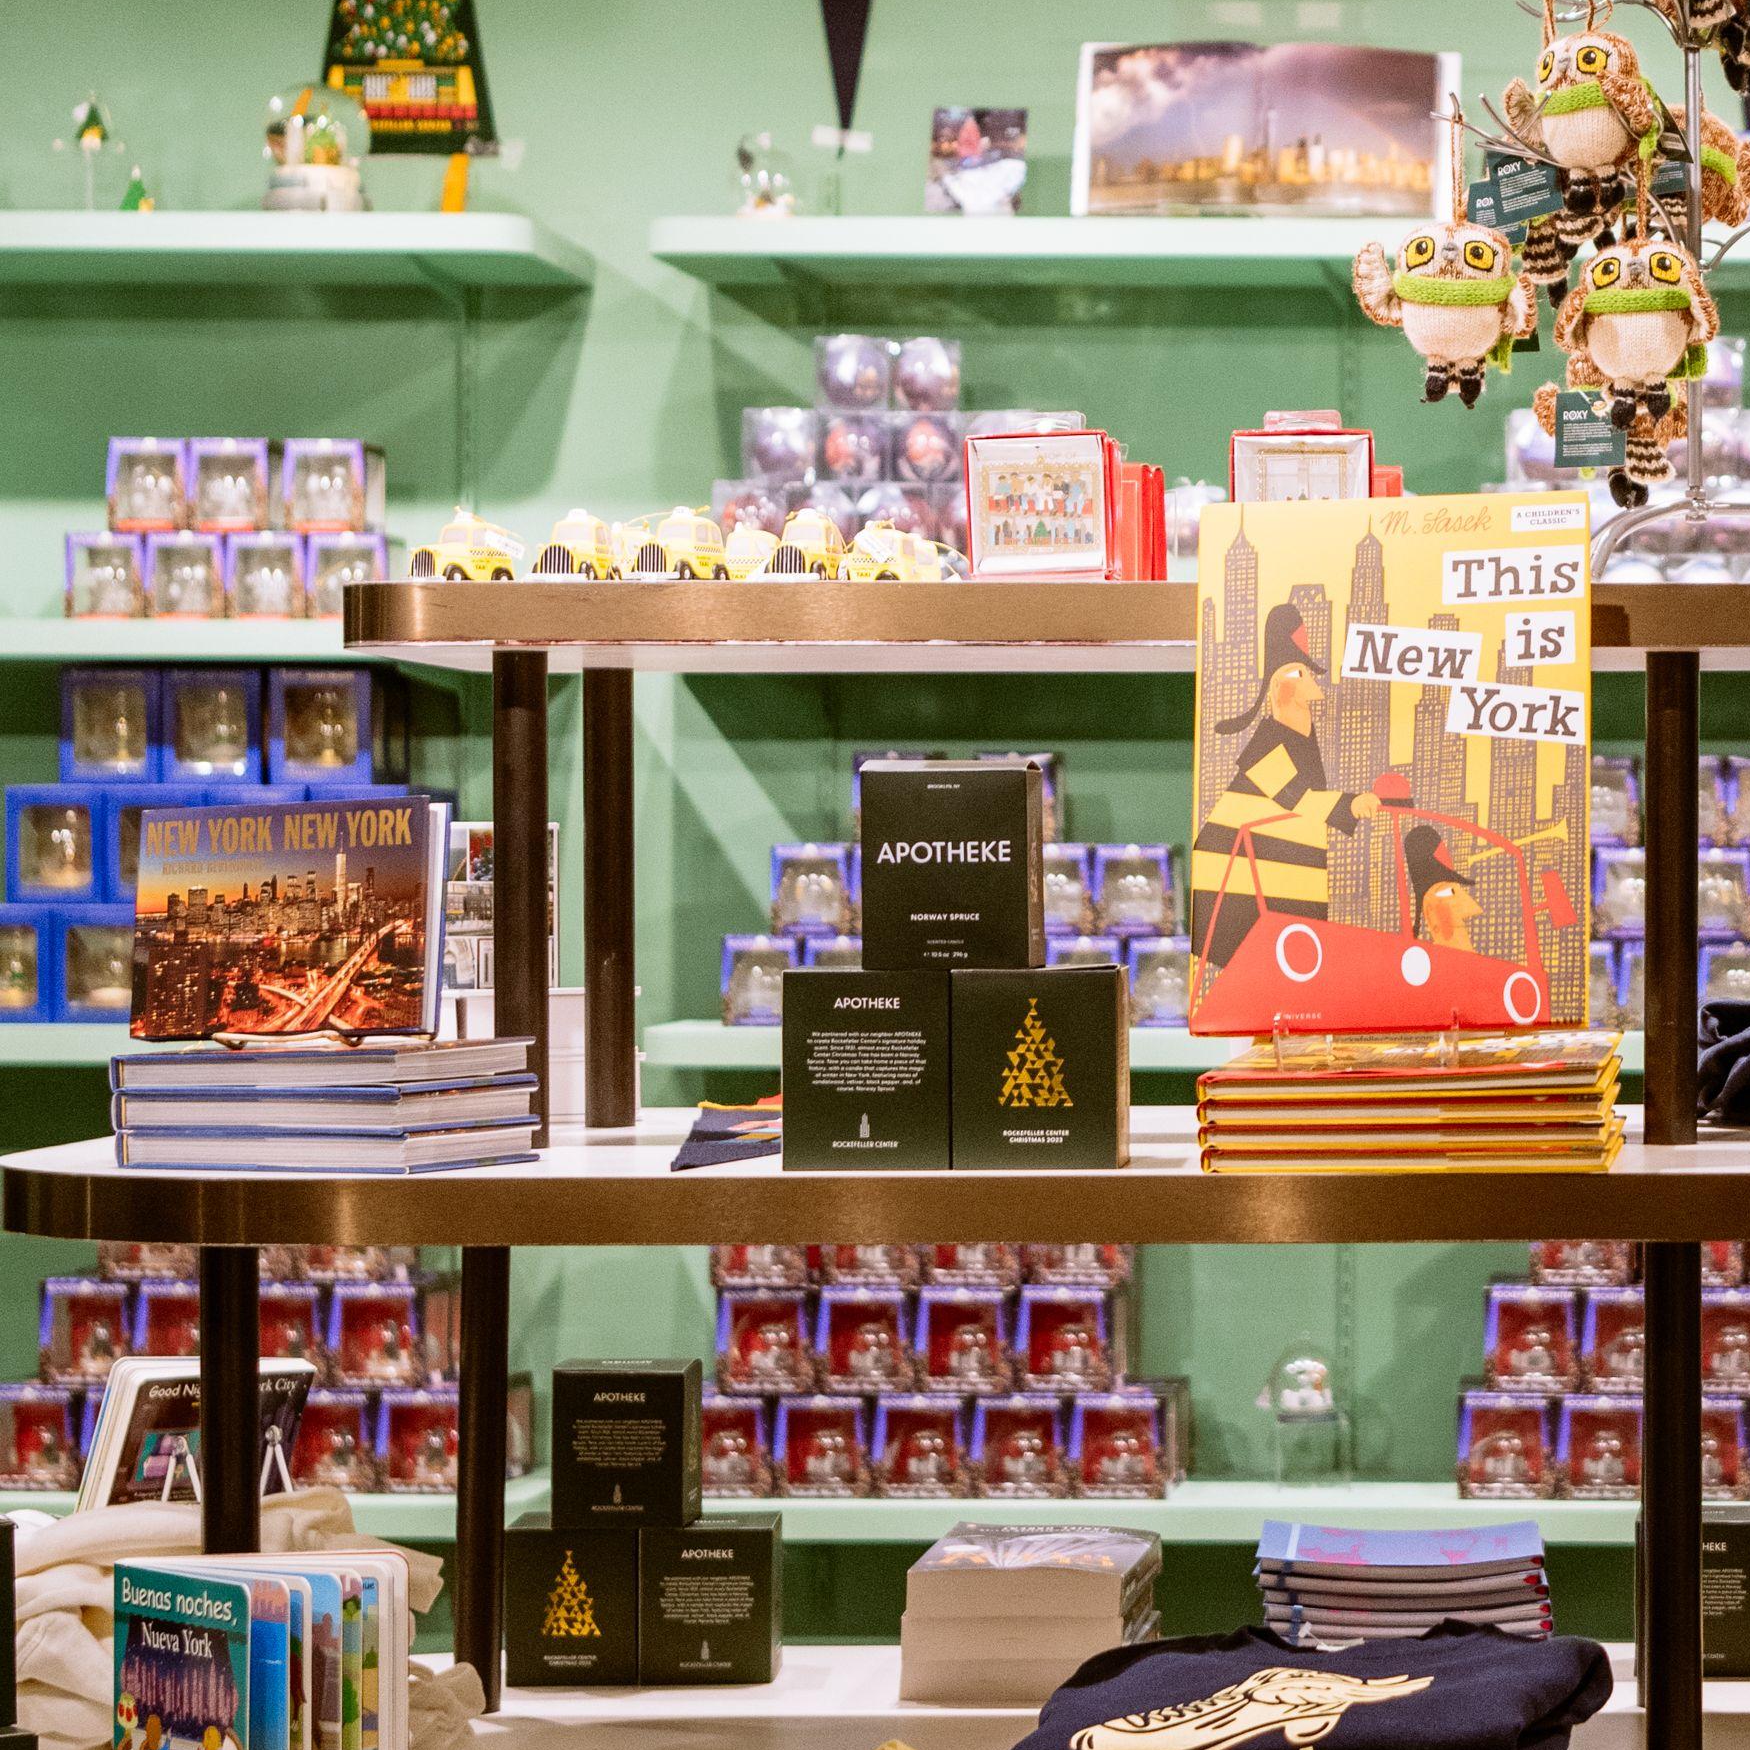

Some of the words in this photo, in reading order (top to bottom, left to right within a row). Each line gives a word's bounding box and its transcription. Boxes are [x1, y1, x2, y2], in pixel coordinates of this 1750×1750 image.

[1497, 161, 1522, 176] ROXY
[1476, 198, 1493, 208] ROX
[1562, 410, 1588, 420] ROXY
[1380, 510, 1417, 536] M.
[1423, 504, 1493, 535] Sasek
[1525, 508, 1580, 518] CHILDREN'S
[1529, 516, 1566, 526] CLASSIC
[1452, 554, 1579, 598] This
[1516, 618, 1565, 660] is
[1349, 630, 1473, 679] New
[1460, 686, 1579, 737] York
[146, 820, 201, 858] NEW
[207, 815, 273, 853] YORK
[284, 812, 339, 851] NEW
[346, 807, 413, 848] YORK
[876, 840, 1011, 864] APOTHEKE
[910, 913, 948, 922] NORWAY
[949, 913, 980, 921] SPRUCE
[834, 997, 900, 1009] APOTHEKE
[832, 1140, 874, 1148] ROCKEFELLER
[875, 1140, 898, 1148] CENTER
[149, 1385, 180, 1398] Good
[183, 1383, 201, 1397] Nig
[275, 1377, 298, 1396] City
[593, 1392, 646, 1402] APOTHEKE
[681, 1549, 734, 1559] APOTHEKE
[1702, 1542, 1727, 1551] HEKE
[121, 1576, 172, 1611] Buenas
[176, 1590, 238, 1627] noches,
[141, 1621, 180, 1653] Nueva
[181, 1628, 214, 1659] York
